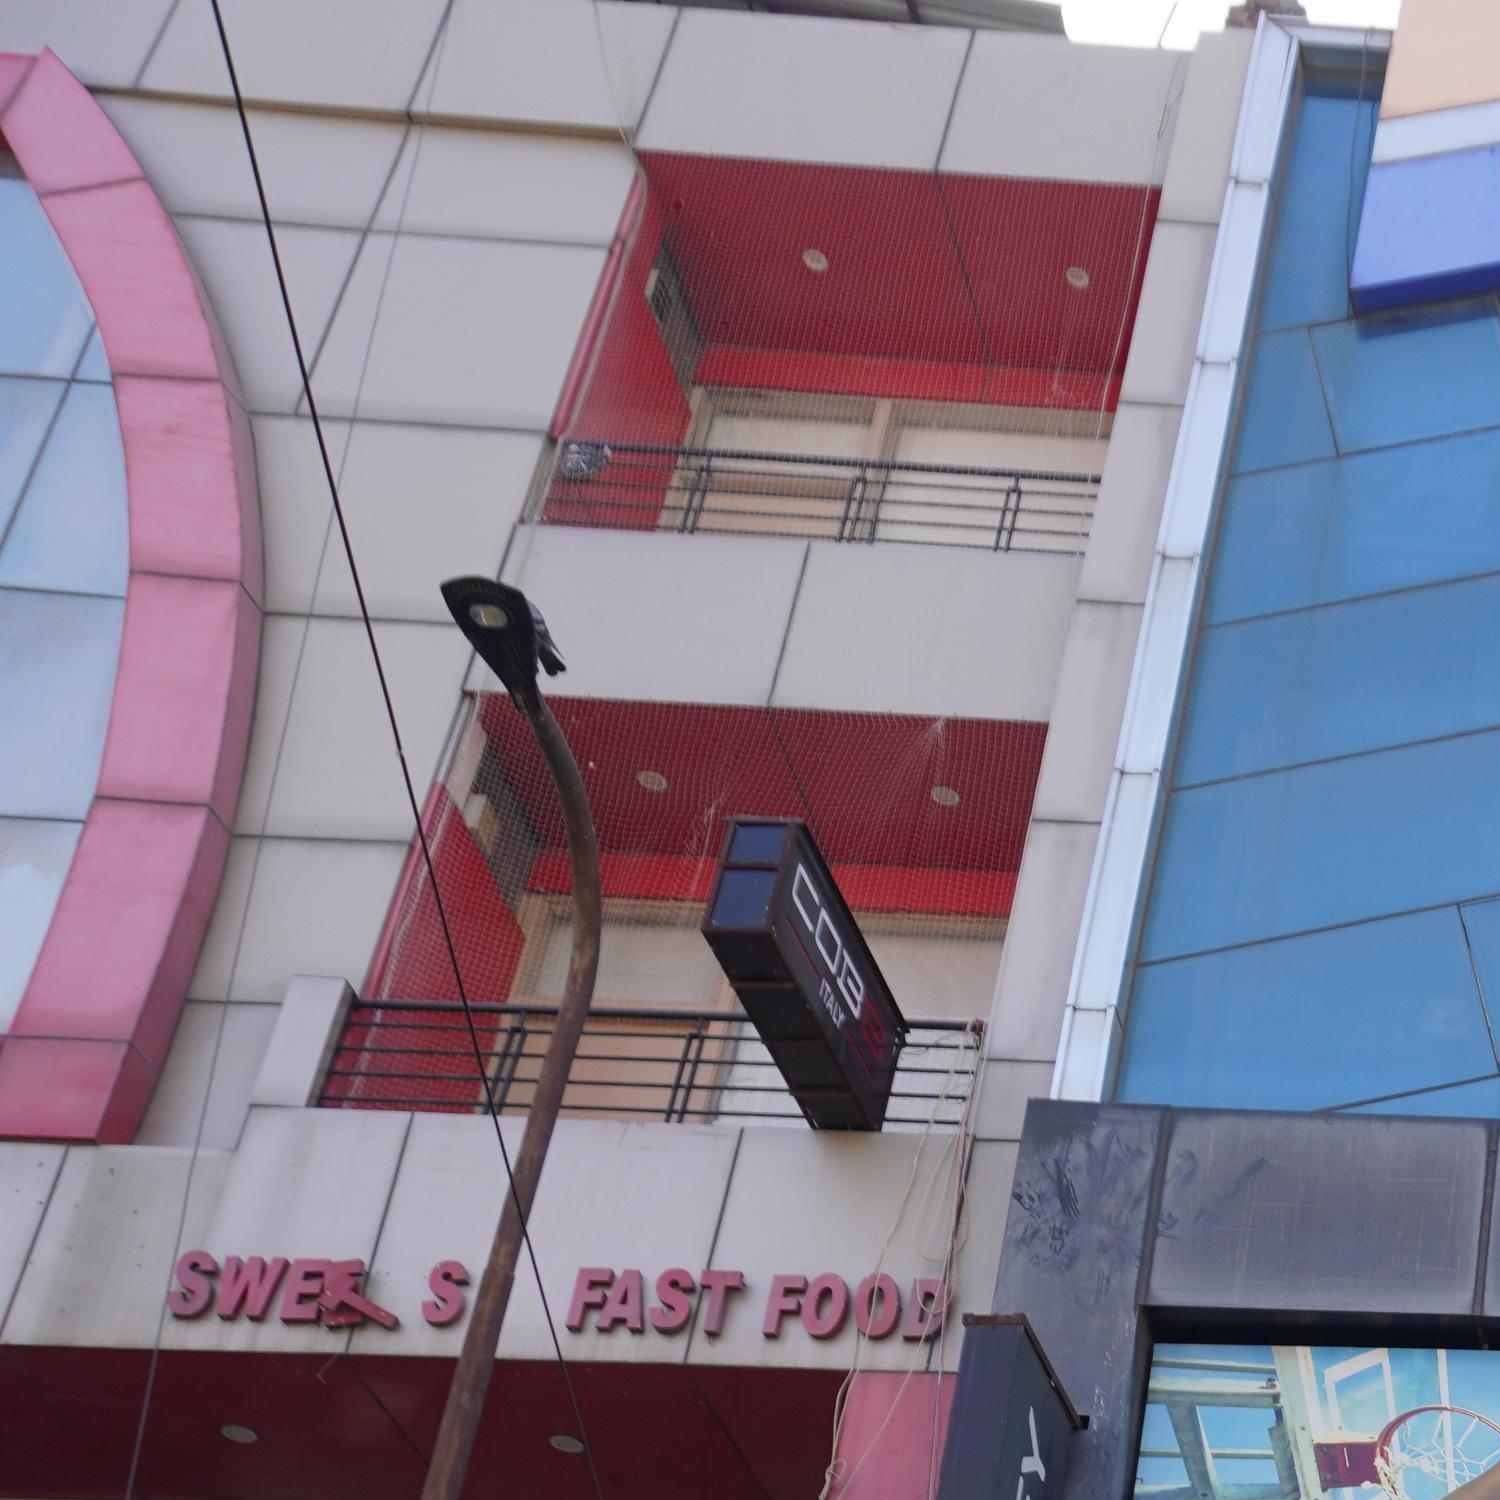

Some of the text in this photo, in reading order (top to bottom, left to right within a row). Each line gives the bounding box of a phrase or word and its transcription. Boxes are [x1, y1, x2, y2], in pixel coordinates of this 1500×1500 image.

[818, 976, 847, 1030] ITALY
[566, 1266, 747, 1337] FAST
[761, 1271, 952, 1343] FOOD
